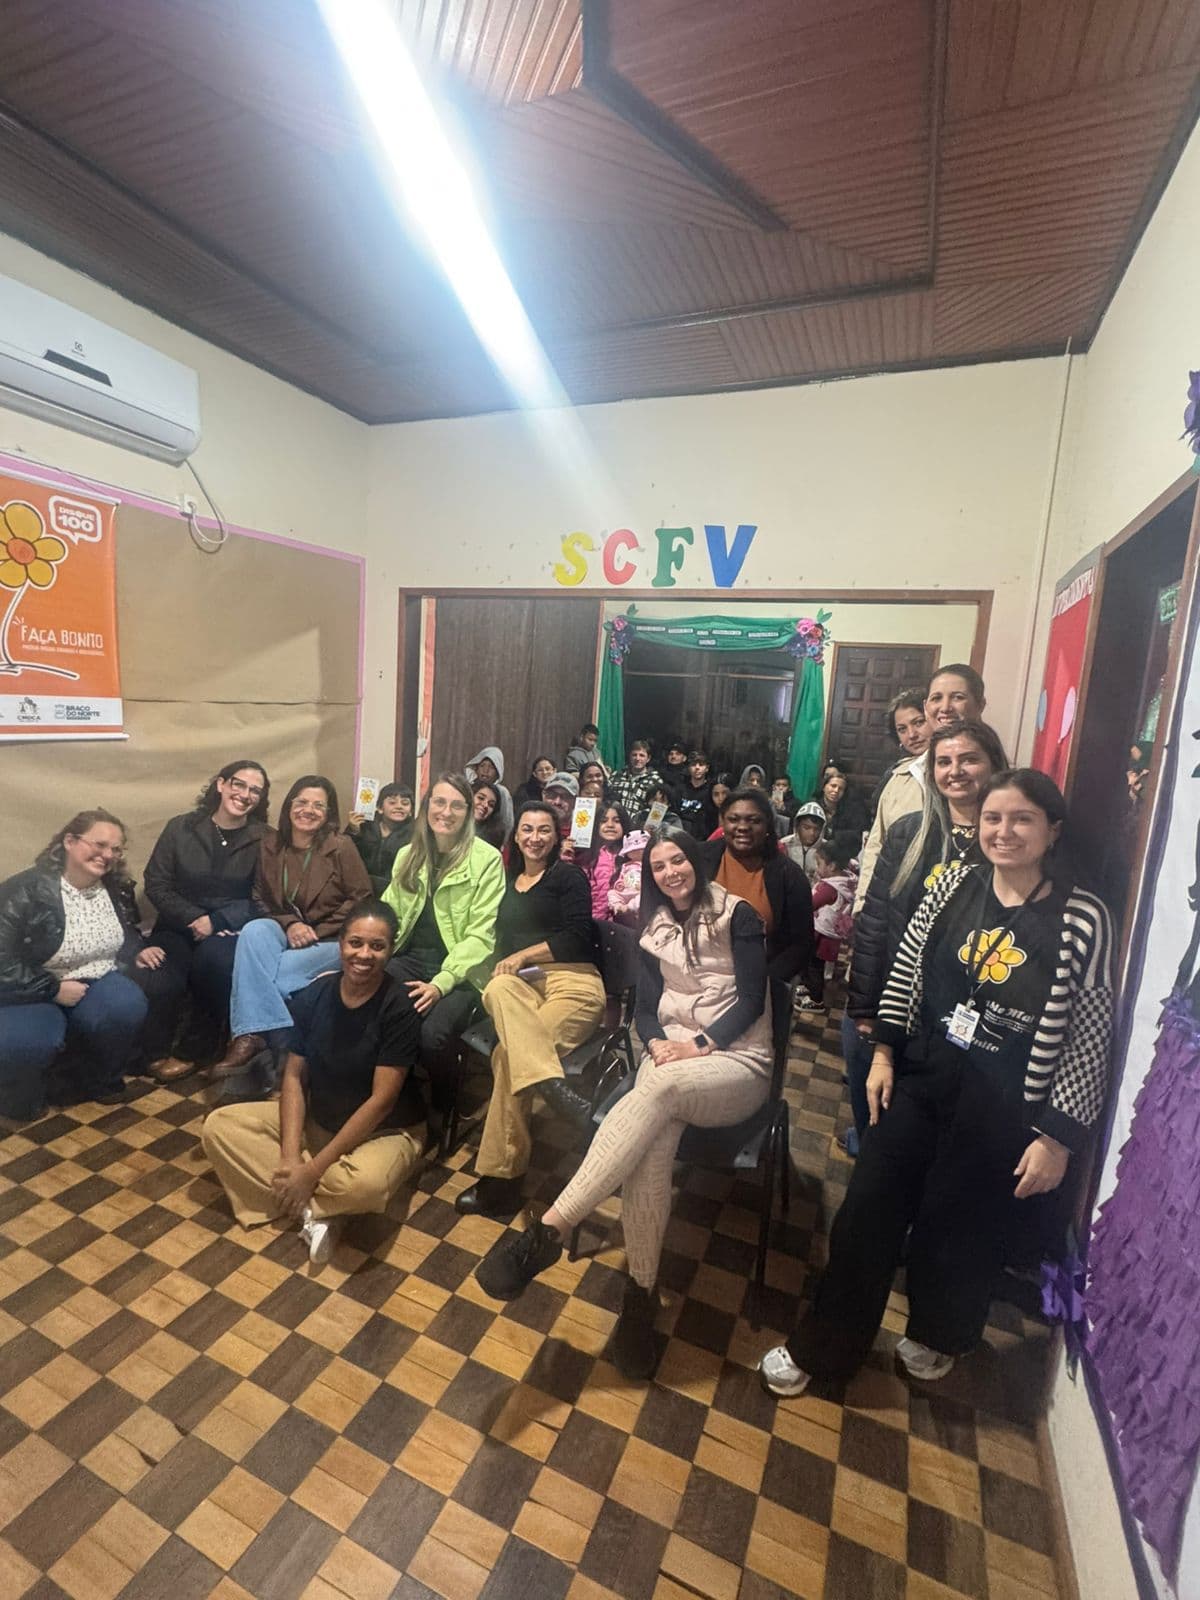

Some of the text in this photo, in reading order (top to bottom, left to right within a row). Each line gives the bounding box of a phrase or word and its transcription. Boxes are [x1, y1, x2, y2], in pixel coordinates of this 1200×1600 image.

[58, 514, 94, 533] 100
[554, 525, 758, 588] SCFV
[21, 624, 104, 649] FAÇA BONITO
